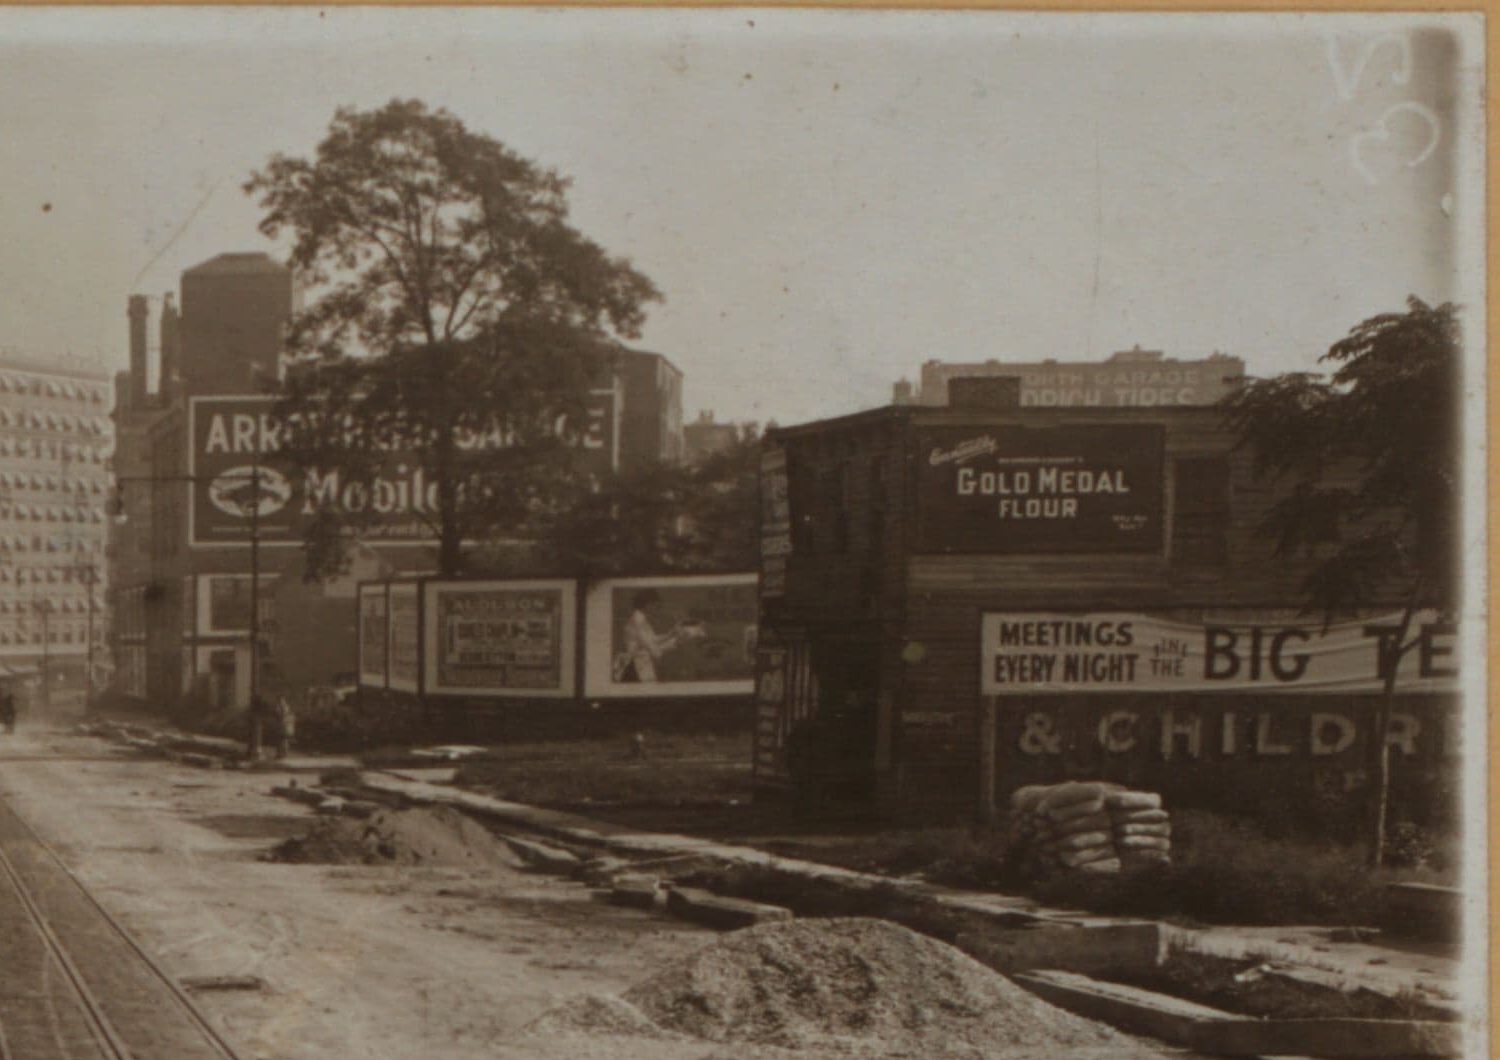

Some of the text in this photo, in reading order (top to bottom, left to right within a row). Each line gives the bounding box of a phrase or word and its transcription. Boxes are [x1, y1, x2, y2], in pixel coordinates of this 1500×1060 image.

[957, 467, 1131, 495] GOLD MEDAL
[999, 498, 1079, 519] FLOUR
[999, 620, 1134, 647] MEETINGS
[994, 653, 1139, 684] EVERY NIGHT
[1150, 658, 1185, 678] THE
[1203, 628, 1315, 682] BIG
[1017, 711, 1062, 755] &
